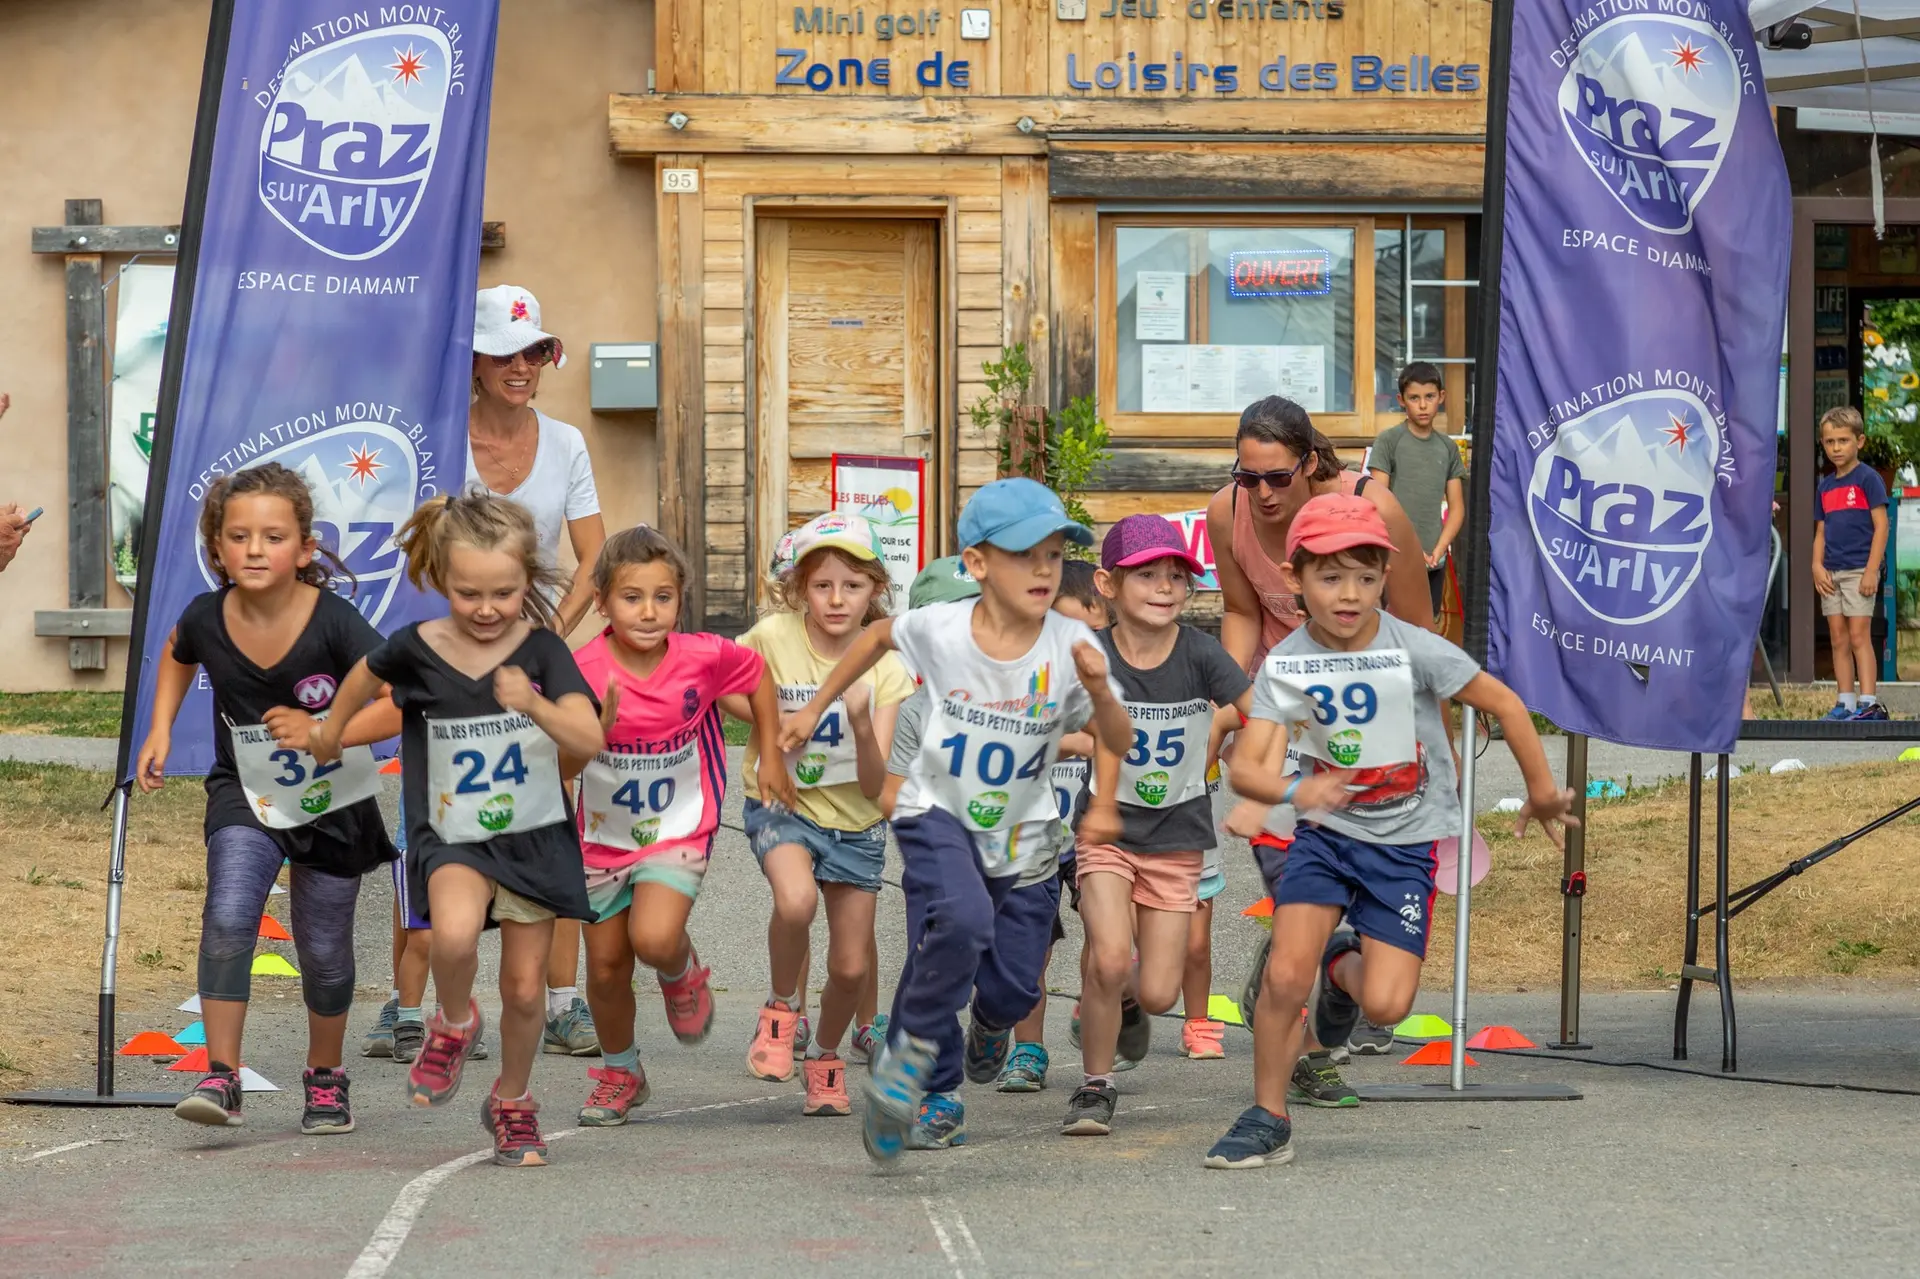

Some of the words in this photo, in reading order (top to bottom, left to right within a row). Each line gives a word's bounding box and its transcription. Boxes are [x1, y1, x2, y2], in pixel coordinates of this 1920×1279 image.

[794, 6, 864, 34] Mini
[875, 8, 941, 40] golf
[380, 4, 465, 96] MONT-BLANC
[775, 48, 890, 92] Zone
[917, 51, 969, 87] de
[1067, 51, 1239, 92] Loisirs
[1260, 55, 1338, 91] des
[1351, 55, 1481, 92] Belles
[1576, 72, 1721, 161] Praz
[266, 101, 433, 179] Praz
[1590, 151, 1623, 176] sur
[668, 173, 691, 188] 95
[265, 181, 309, 202] sur
[298, 184, 407, 237] Arly
[1562, 229, 1639, 256] ESPACE
[1648, 246, 1712, 278] DIAMA
[237, 271, 316, 292] ESPACE
[325, 276, 420, 295] DIAMANT
[1234, 259, 1325, 287] OUVERT
[187, 410, 327, 502] DESTINATION
[335, 402, 437, 498] MONT-BLANC
[854, 493, 889, 506] BELLES
[1545, 455, 1709, 546] Praz
[1549, 537, 1588, 562] sur
[1576, 545, 1682, 605] Arly
[1304, 660, 1321, 674] DES
[1323, 658, 1355, 673] PETITS
[1593, 637, 1695, 667] DIAMANT
[796, 689, 819, 702] PETIT
[1141, 706, 1170, 720] PETITS
[1172, 702, 1208, 719] DRAGONS
[1304, 682, 1378, 725] 39
[451, 724, 467, 740] DES
[469, 720, 501, 738] PETITS
[941, 699, 965, 720] TRAIL
[968, 708, 985, 727] DES
[987, 715, 1022, 735] PETITS
[239, 729, 264, 744] TRAIL
[1327, 739, 1361, 754] Praz
[452, 742, 529, 795] 24
[613, 757, 630, 770] DES
[631, 757, 662, 771] PETITS
[940, 732, 1050, 787] 104
[611, 777, 676, 815] 40
[1135, 780, 1168, 794] Praz
[968, 799, 1005, 815] Praz
